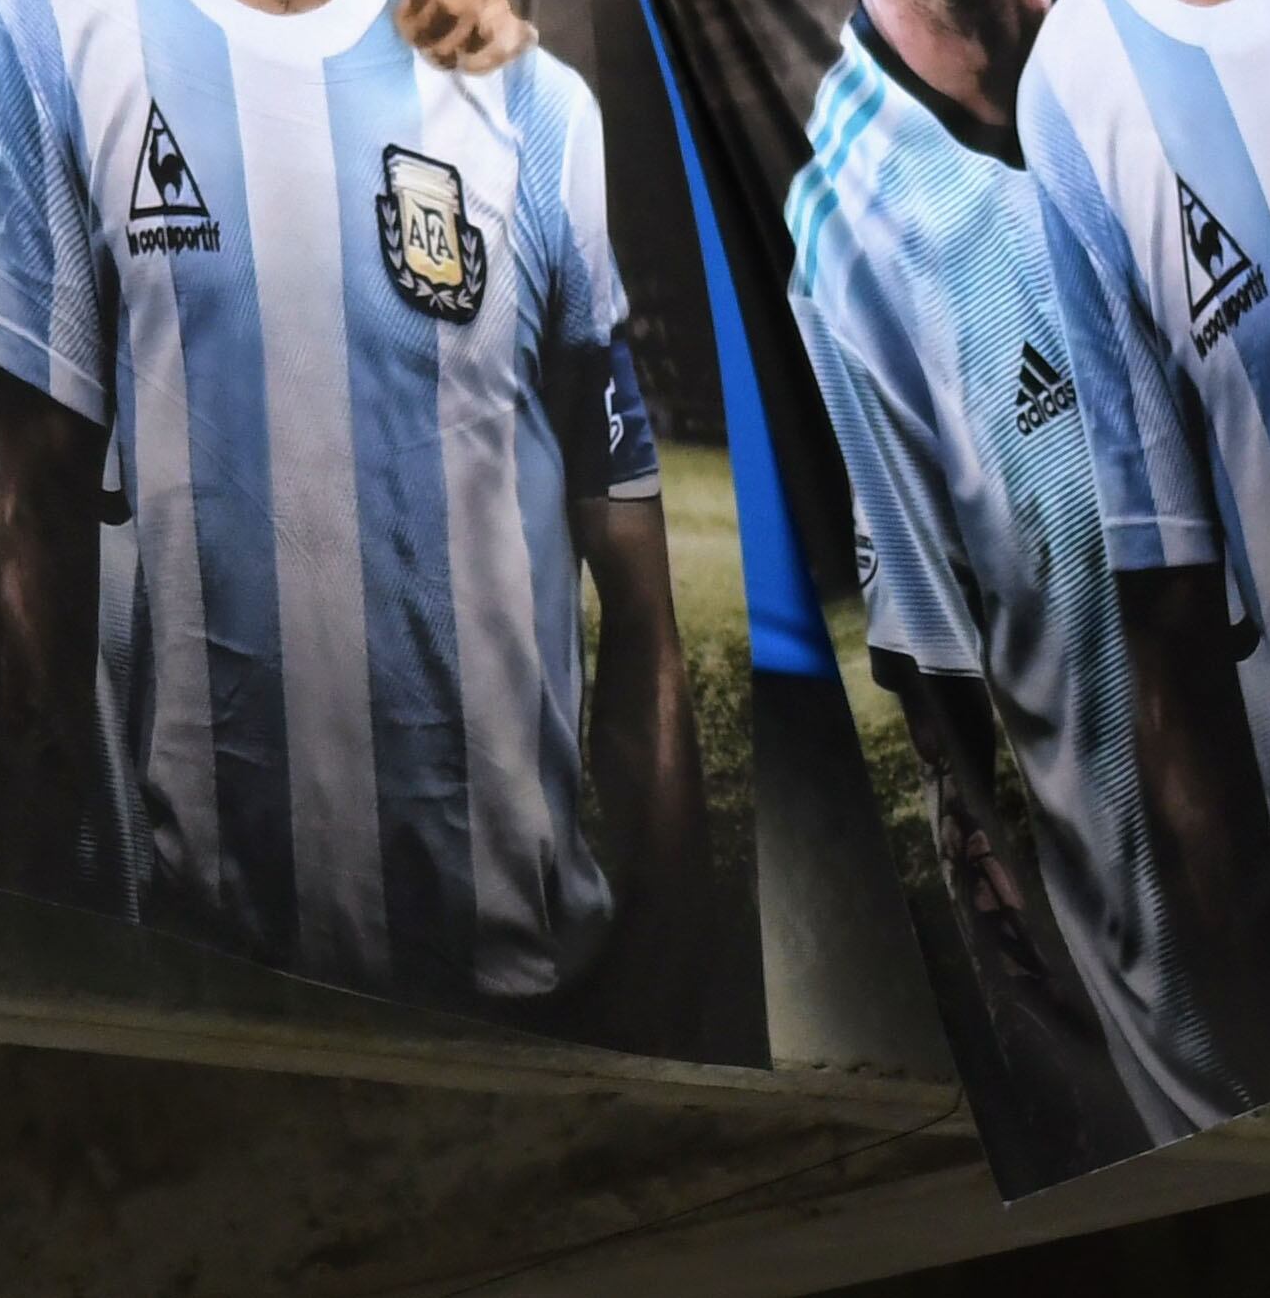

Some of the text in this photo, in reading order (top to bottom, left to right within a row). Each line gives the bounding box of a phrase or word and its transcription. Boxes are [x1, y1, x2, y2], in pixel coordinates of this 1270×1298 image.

[167, 220, 221, 257] portif
[409, 198, 454, 265] AFA
[1016, 380, 1077, 437] adidas
